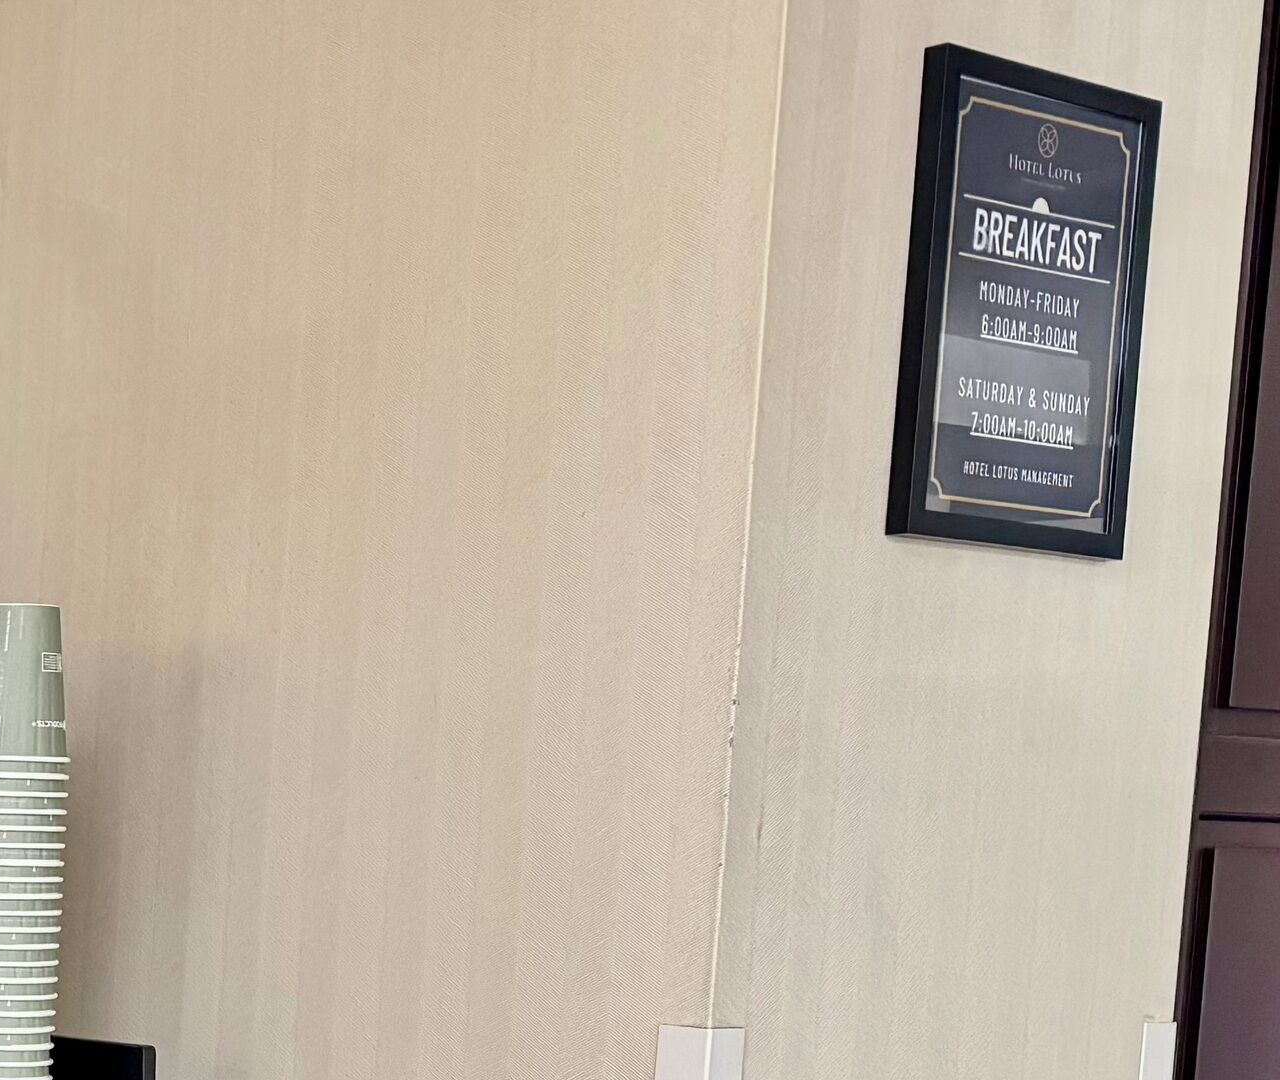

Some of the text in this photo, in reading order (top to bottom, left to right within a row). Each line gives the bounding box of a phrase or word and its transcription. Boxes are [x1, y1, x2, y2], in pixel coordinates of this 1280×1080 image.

[973, 207, 1102, 274] BREAKFAST
[980, 280, 1080, 319] MONDAY-FRIDAY
[981, 314, 1078, 350] 6:00AM-9:00AM
[958, 376, 1090, 417] SATURDAY & SUNDAY
[970, 411, 1073, 447] 7:00AM-10:00AM
[963, 460, 1075, 488] HOTEL LOTUS MANAGEMENT
